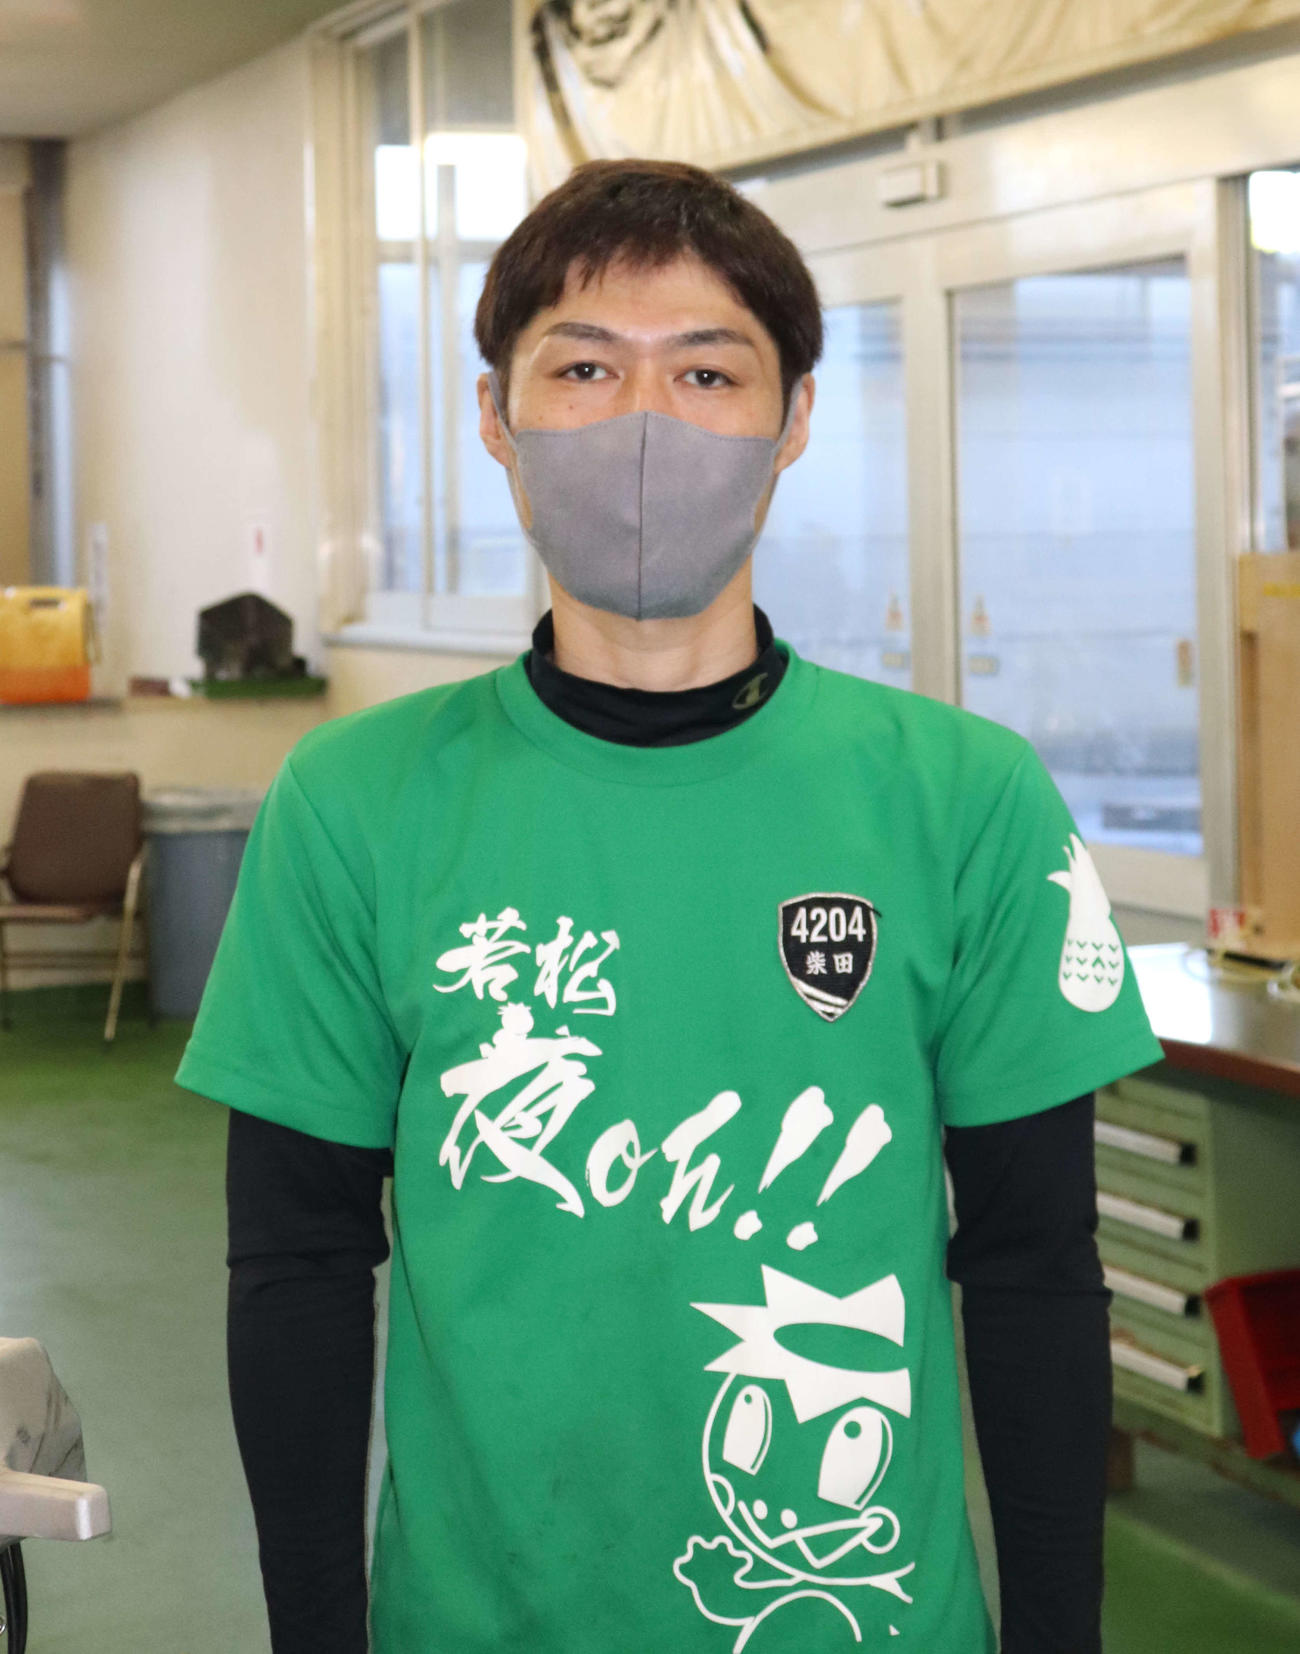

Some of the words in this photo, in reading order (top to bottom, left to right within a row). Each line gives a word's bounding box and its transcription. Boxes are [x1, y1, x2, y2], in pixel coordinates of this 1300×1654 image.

[790, 905, 867, 943] 4204
[433, 906, 621, 1017] 若松
[805, 950, 854, 975] 柴田
